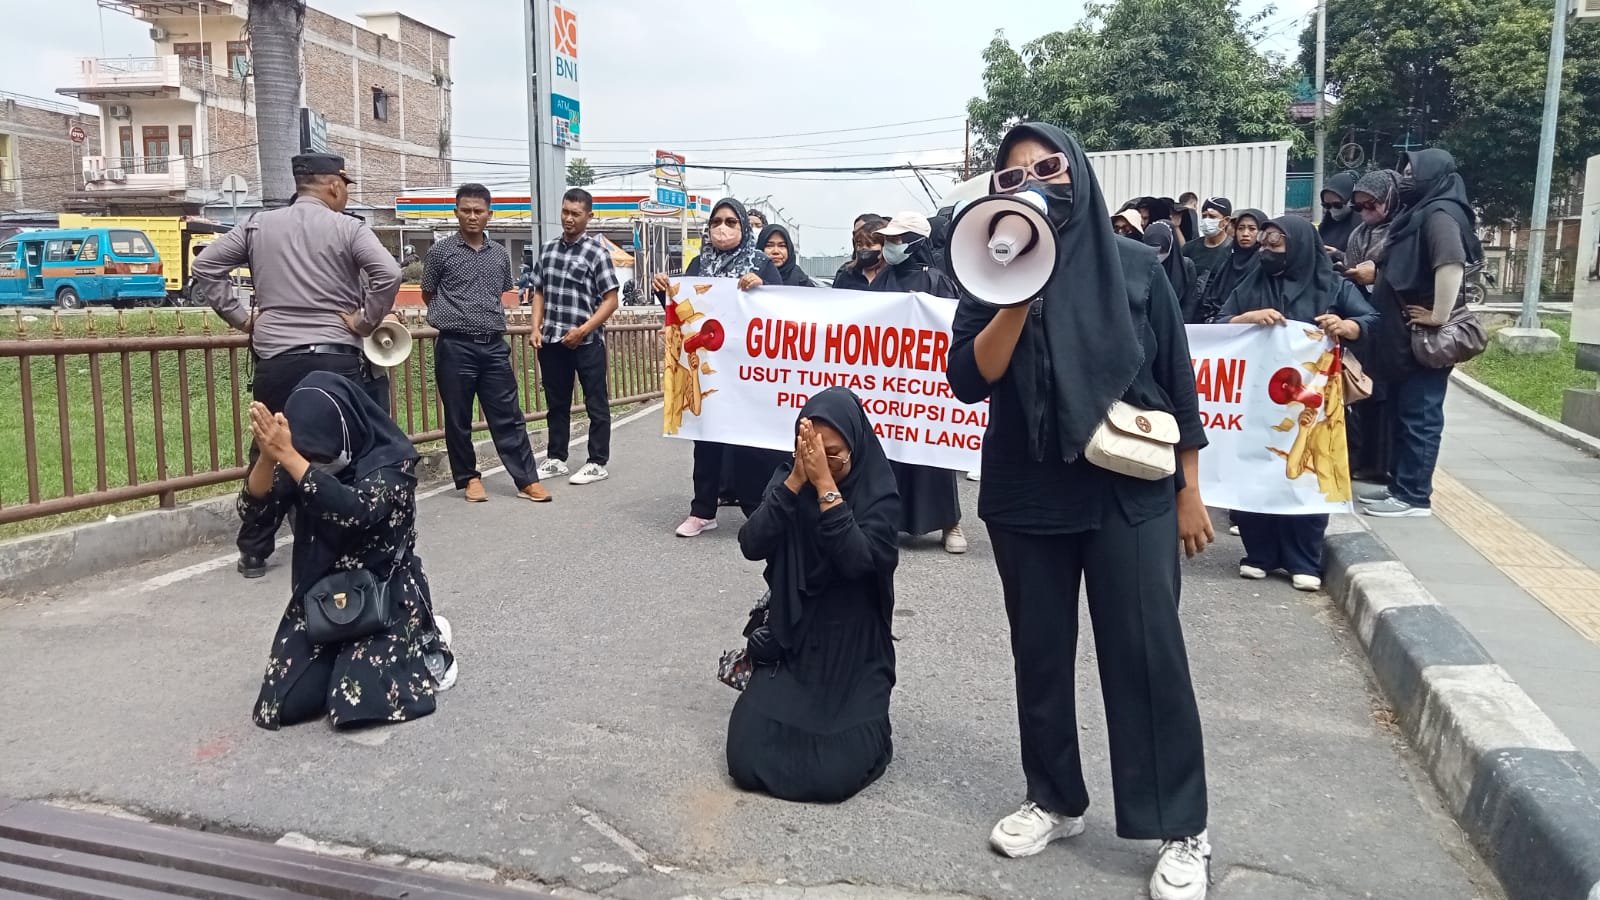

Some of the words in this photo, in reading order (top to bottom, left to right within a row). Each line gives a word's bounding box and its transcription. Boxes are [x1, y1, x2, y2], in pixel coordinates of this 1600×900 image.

[556, 56, 578, 82] BNI
[557, 100, 570, 111] ATM
[746, 317, 817, 362] GURU
[824, 324, 949, 373] HONORER
[1191, 358, 1246, 404] AN!
[739, 365, 791, 384] USUT
[797, 370, 876, 390] TUNTAS
[882, 376, 955, 399] KECUR
[777, 392, 809, 409] PID
[859, 398, 946, 422] KORUPSI
[951, 408, 989, 428] DAL
[872, 422, 919, 442] ATEN
[925, 428, 981, 451] LANG
